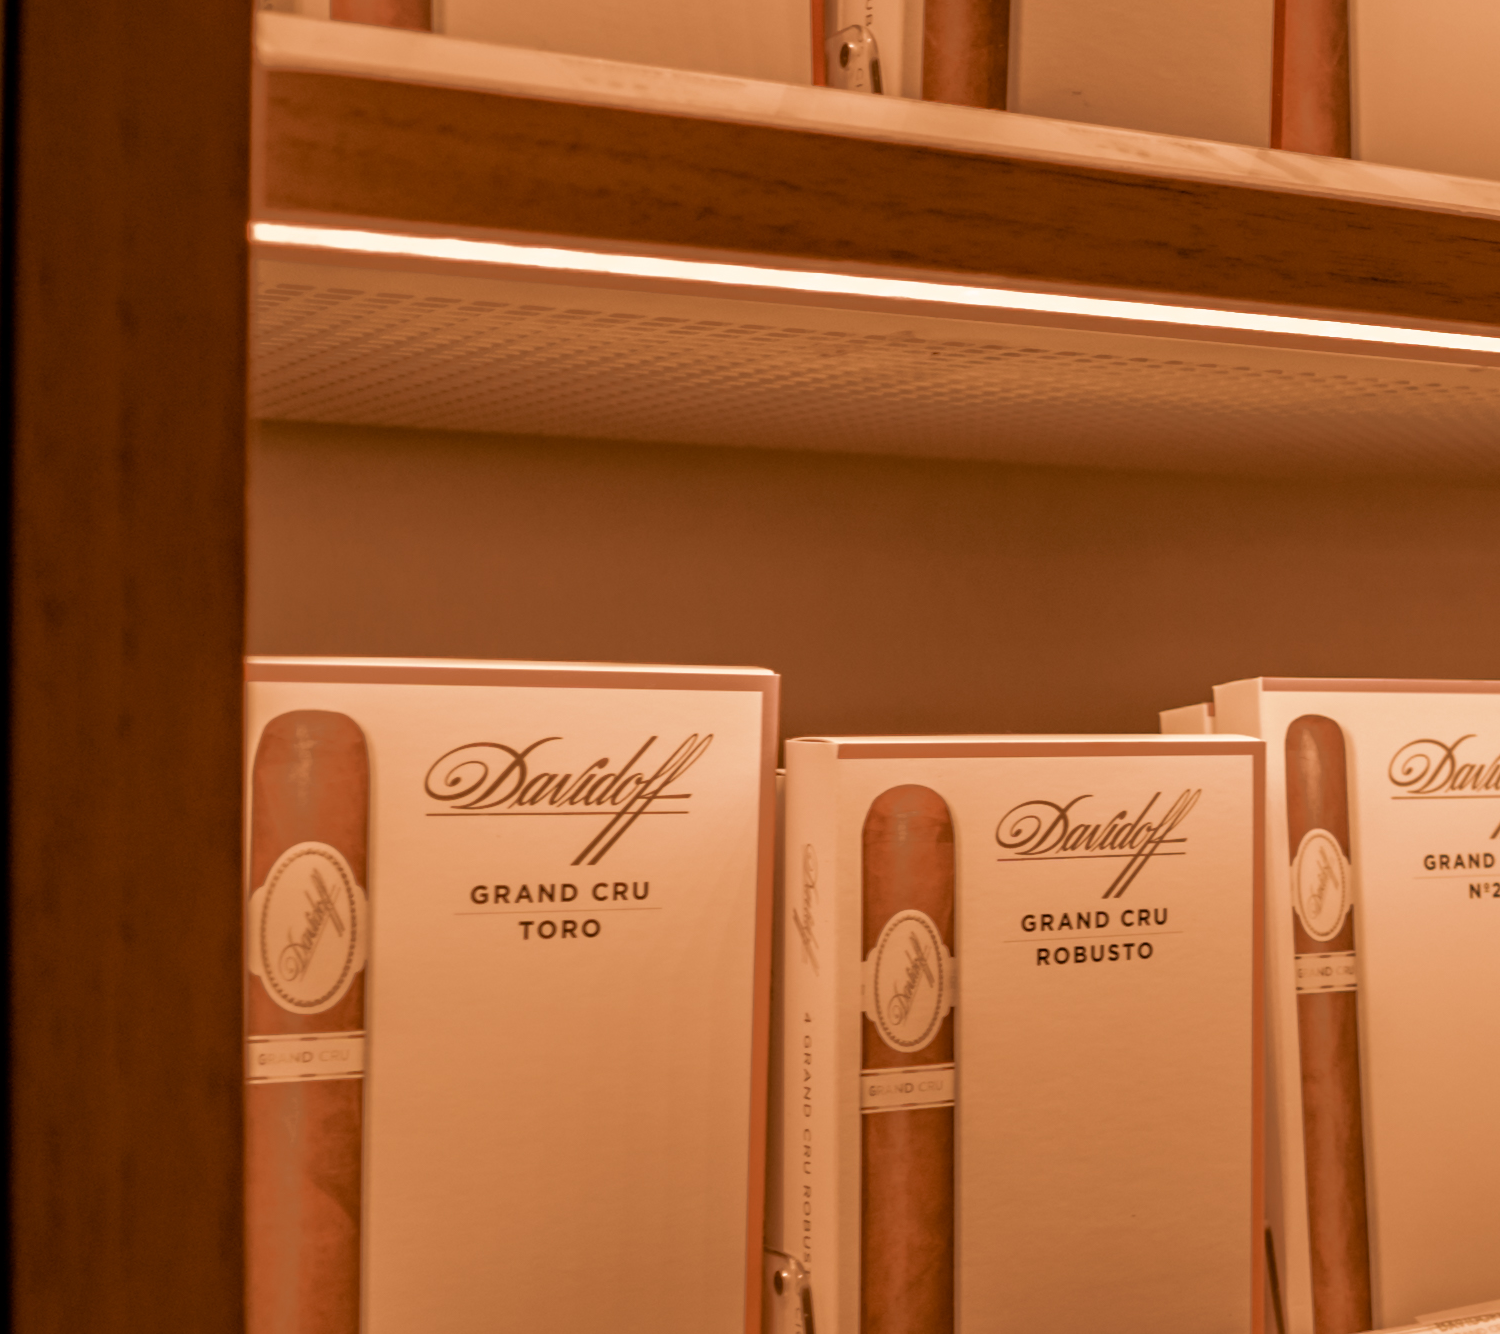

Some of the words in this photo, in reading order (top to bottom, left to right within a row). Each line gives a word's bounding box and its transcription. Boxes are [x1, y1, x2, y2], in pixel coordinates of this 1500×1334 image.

[425, 733, 714, 865] Davidoff
[996, 789, 1202, 899] Davidoff
[1424, 853, 1495, 871] GRAND
[470, 882, 578, 905] GRAND
[592, 881, 650, 901] CRU
[518, 919, 601, 940] TORO
[1021, 911, 1110, 932] GRAND
[1120, 908, 1169, 926] CRU
[1036, 942, 1154, 966] ROBUSTO
[257, 1050, 314, 1067] GRAND
[318, 1047, 351, 1063] CRU
[802, 1035, 813, 1118] GRAND
[869, 1082, 915, 1097] GRAND
[918, 1080, 944, 1093] CRU
[802, 1128, 813, 1175] CRU
[800, 1185, 812, 1289] ROBUST
